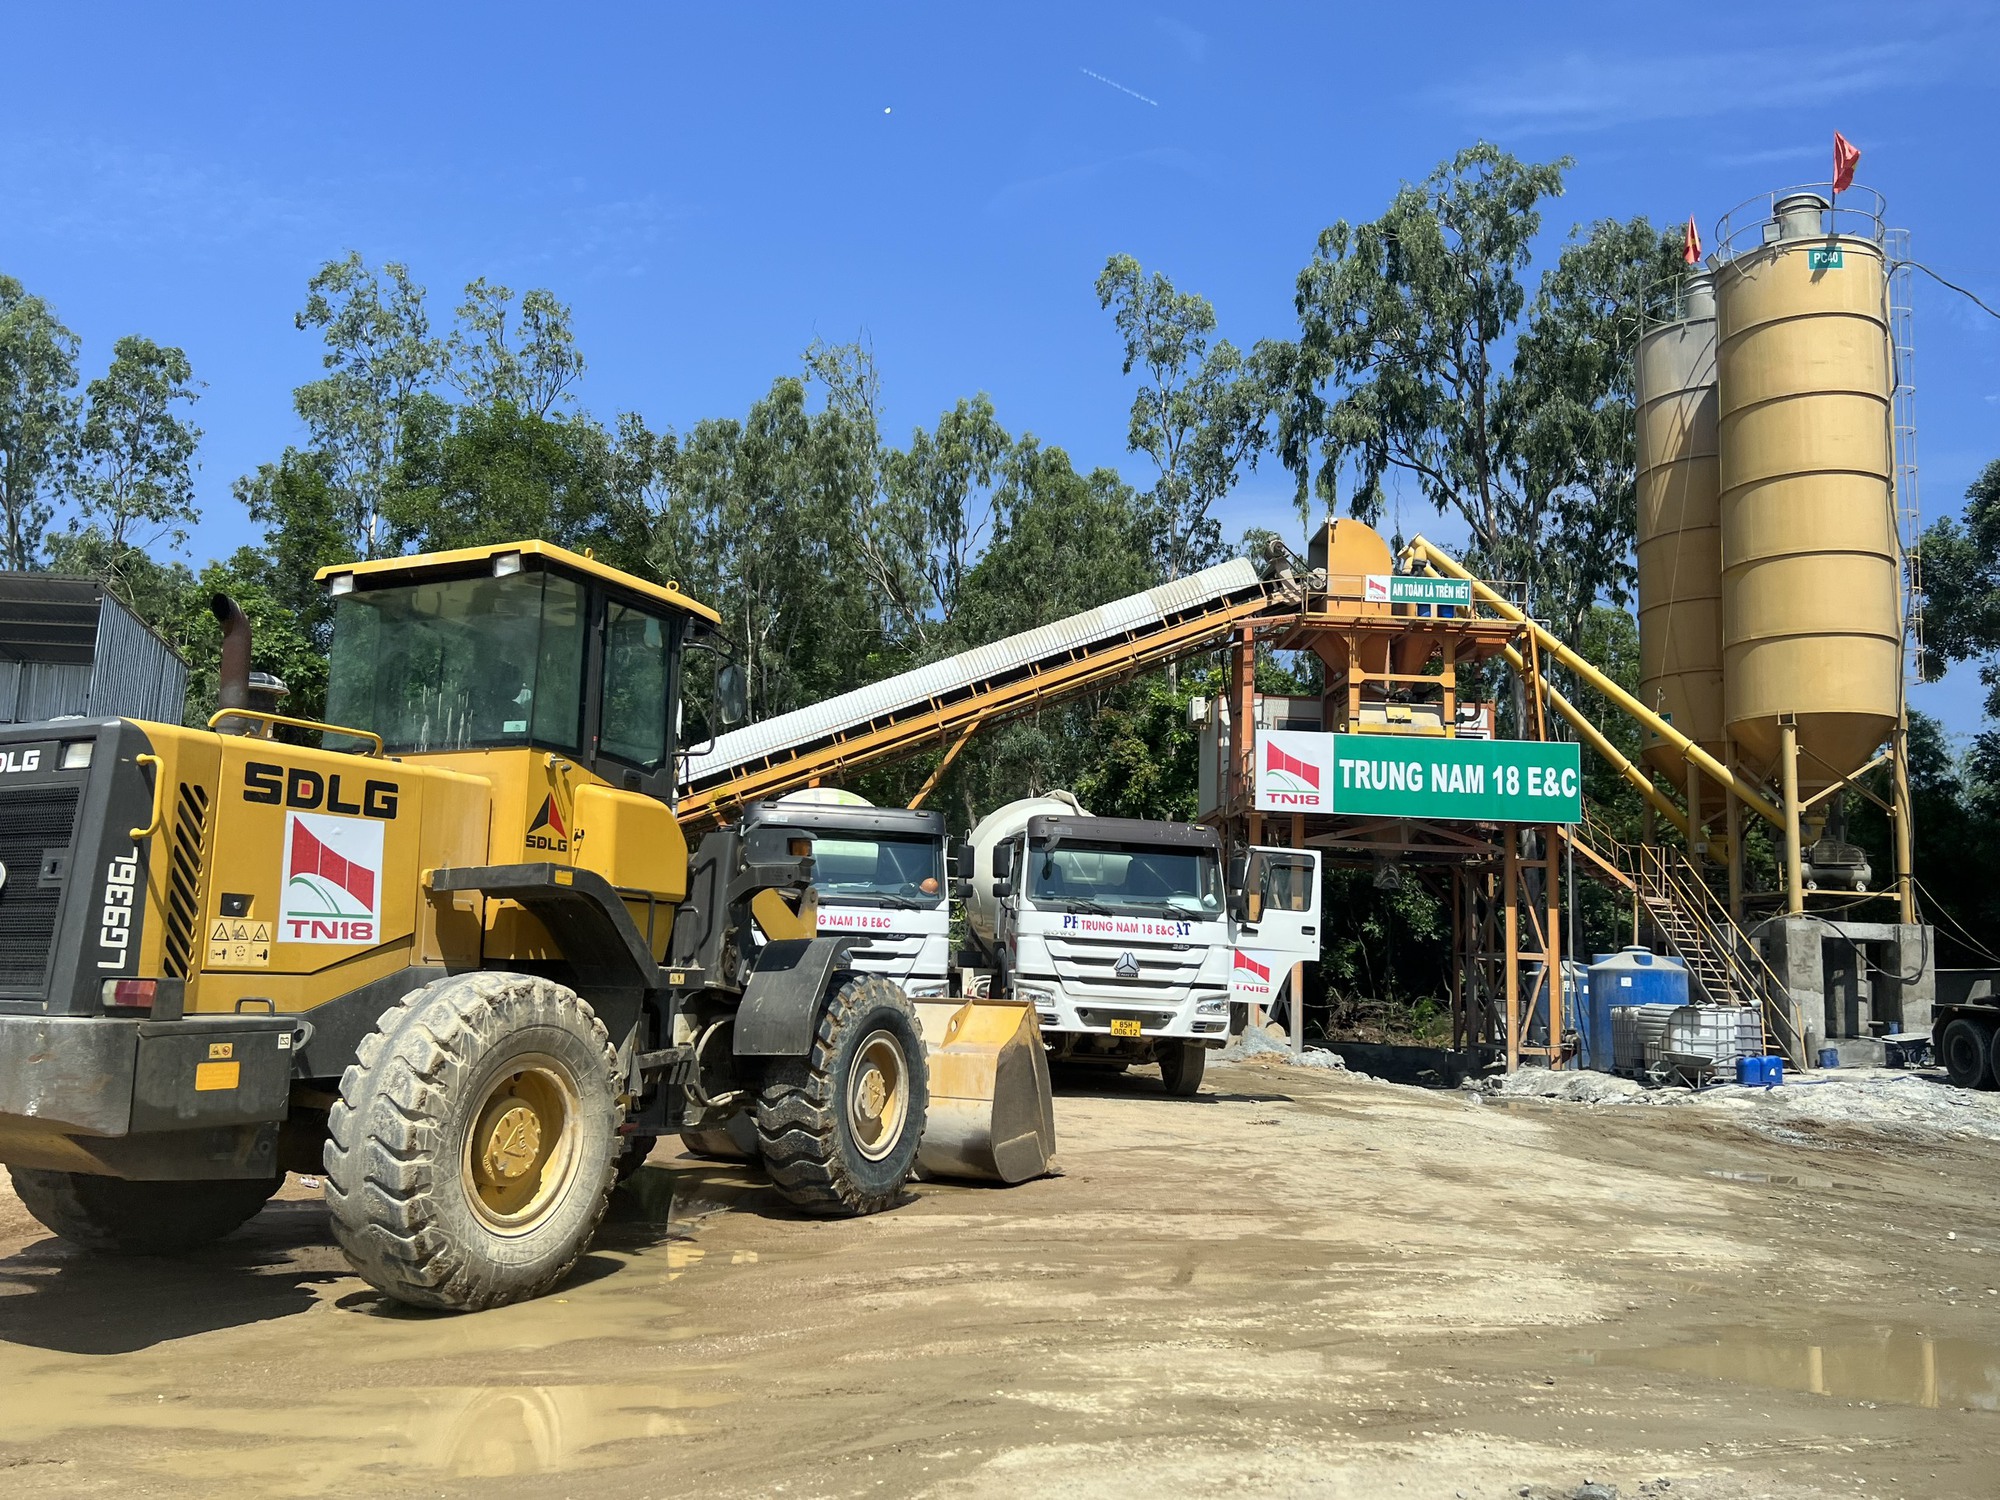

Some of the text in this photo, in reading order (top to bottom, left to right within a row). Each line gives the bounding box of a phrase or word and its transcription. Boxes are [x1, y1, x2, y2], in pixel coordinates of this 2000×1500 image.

[1814, 252, 1839, 264] PC40
[1392, 581, 1469, 599] AN TOÀN LÀ TRÊN HẾT
[1338, 758, 1577, 798] TRUNG NAM 18 E&C
[243, 761, 399, 820] SDLG
[1266, 793, 1320, 806] TN18
[525, 834, 568, 853] SDLG
[97, 846, 139, 969] LG936L
[286, 919, 374, 940] TN18
[829, 915, 853, 927] NAM
[856, 917, 868, 928] 18
[870, 917, 891, 929] E&C
[1081, 919, 1175, 936] TRUNG NAM 18 E&C
[1234, 984, 1270, 993] TN18
